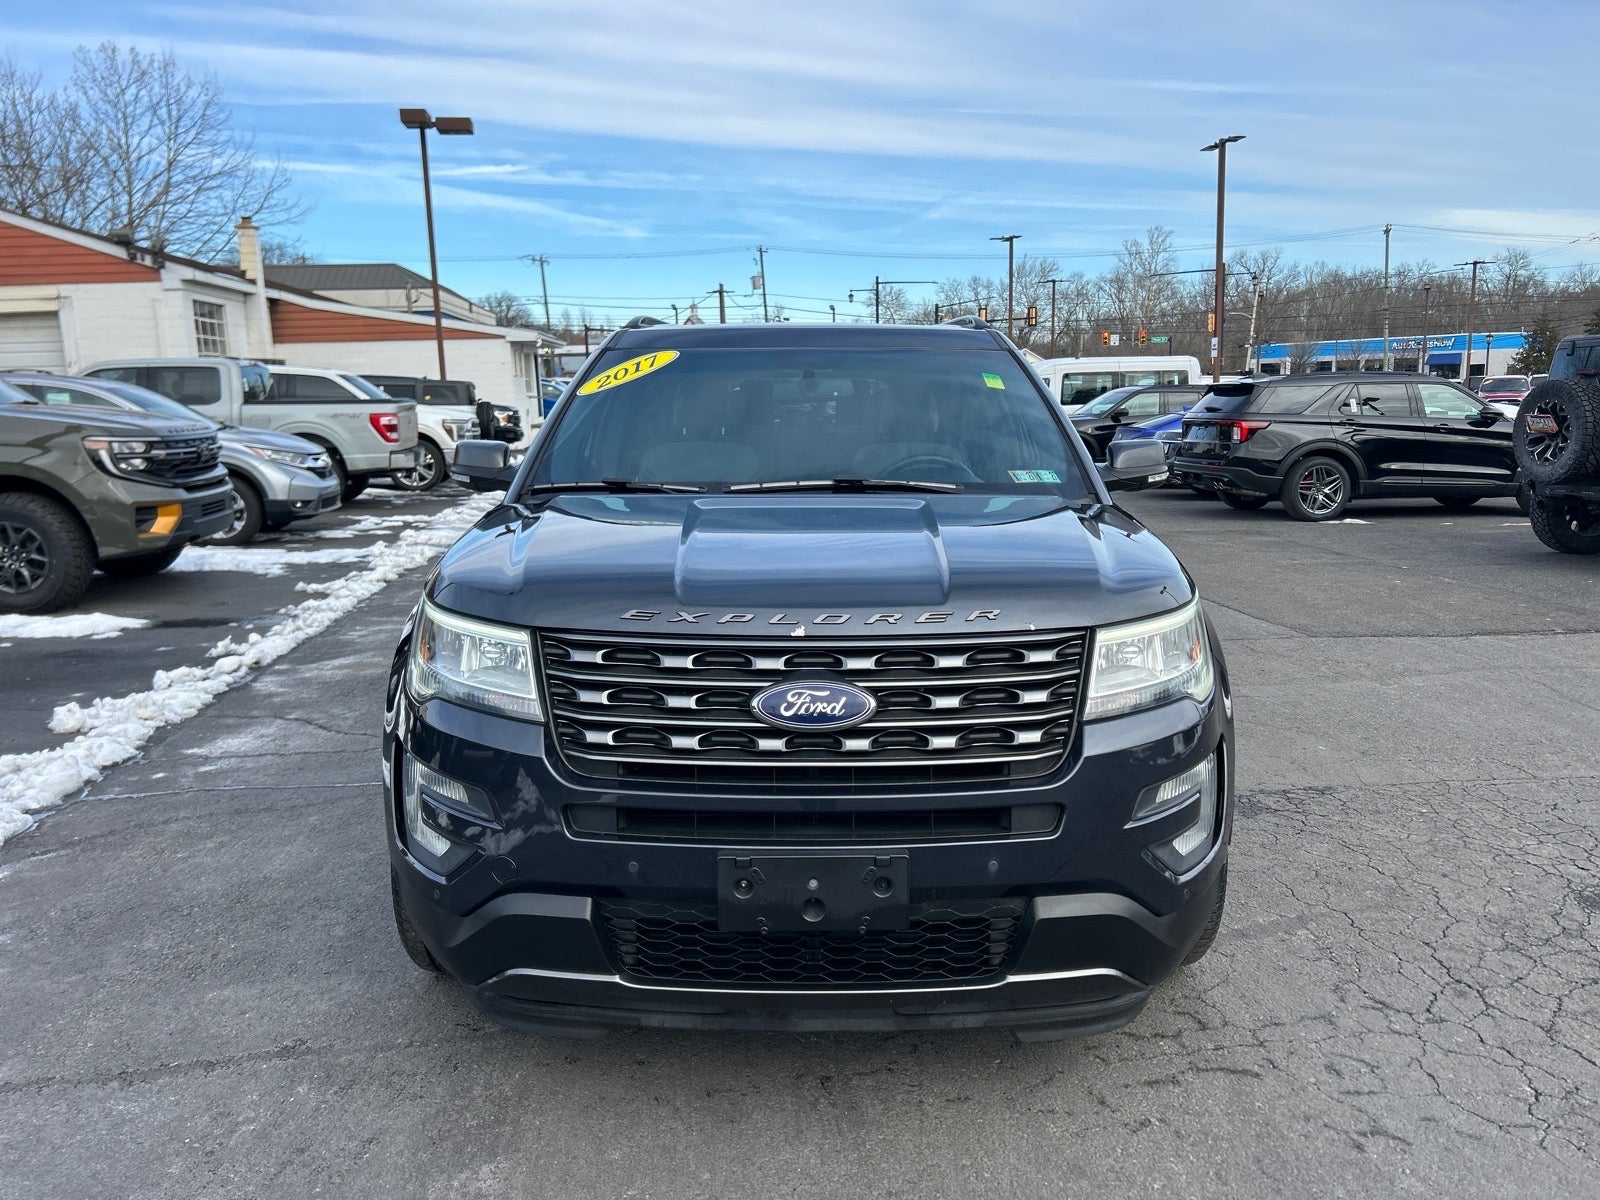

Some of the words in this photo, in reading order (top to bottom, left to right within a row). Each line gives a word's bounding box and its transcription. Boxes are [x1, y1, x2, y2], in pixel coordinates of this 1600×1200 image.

[597, 354, 658, 390] 2017
[620, 609, 1001, 625] EXPLORER
[780, 689, 847, 716] Ford
